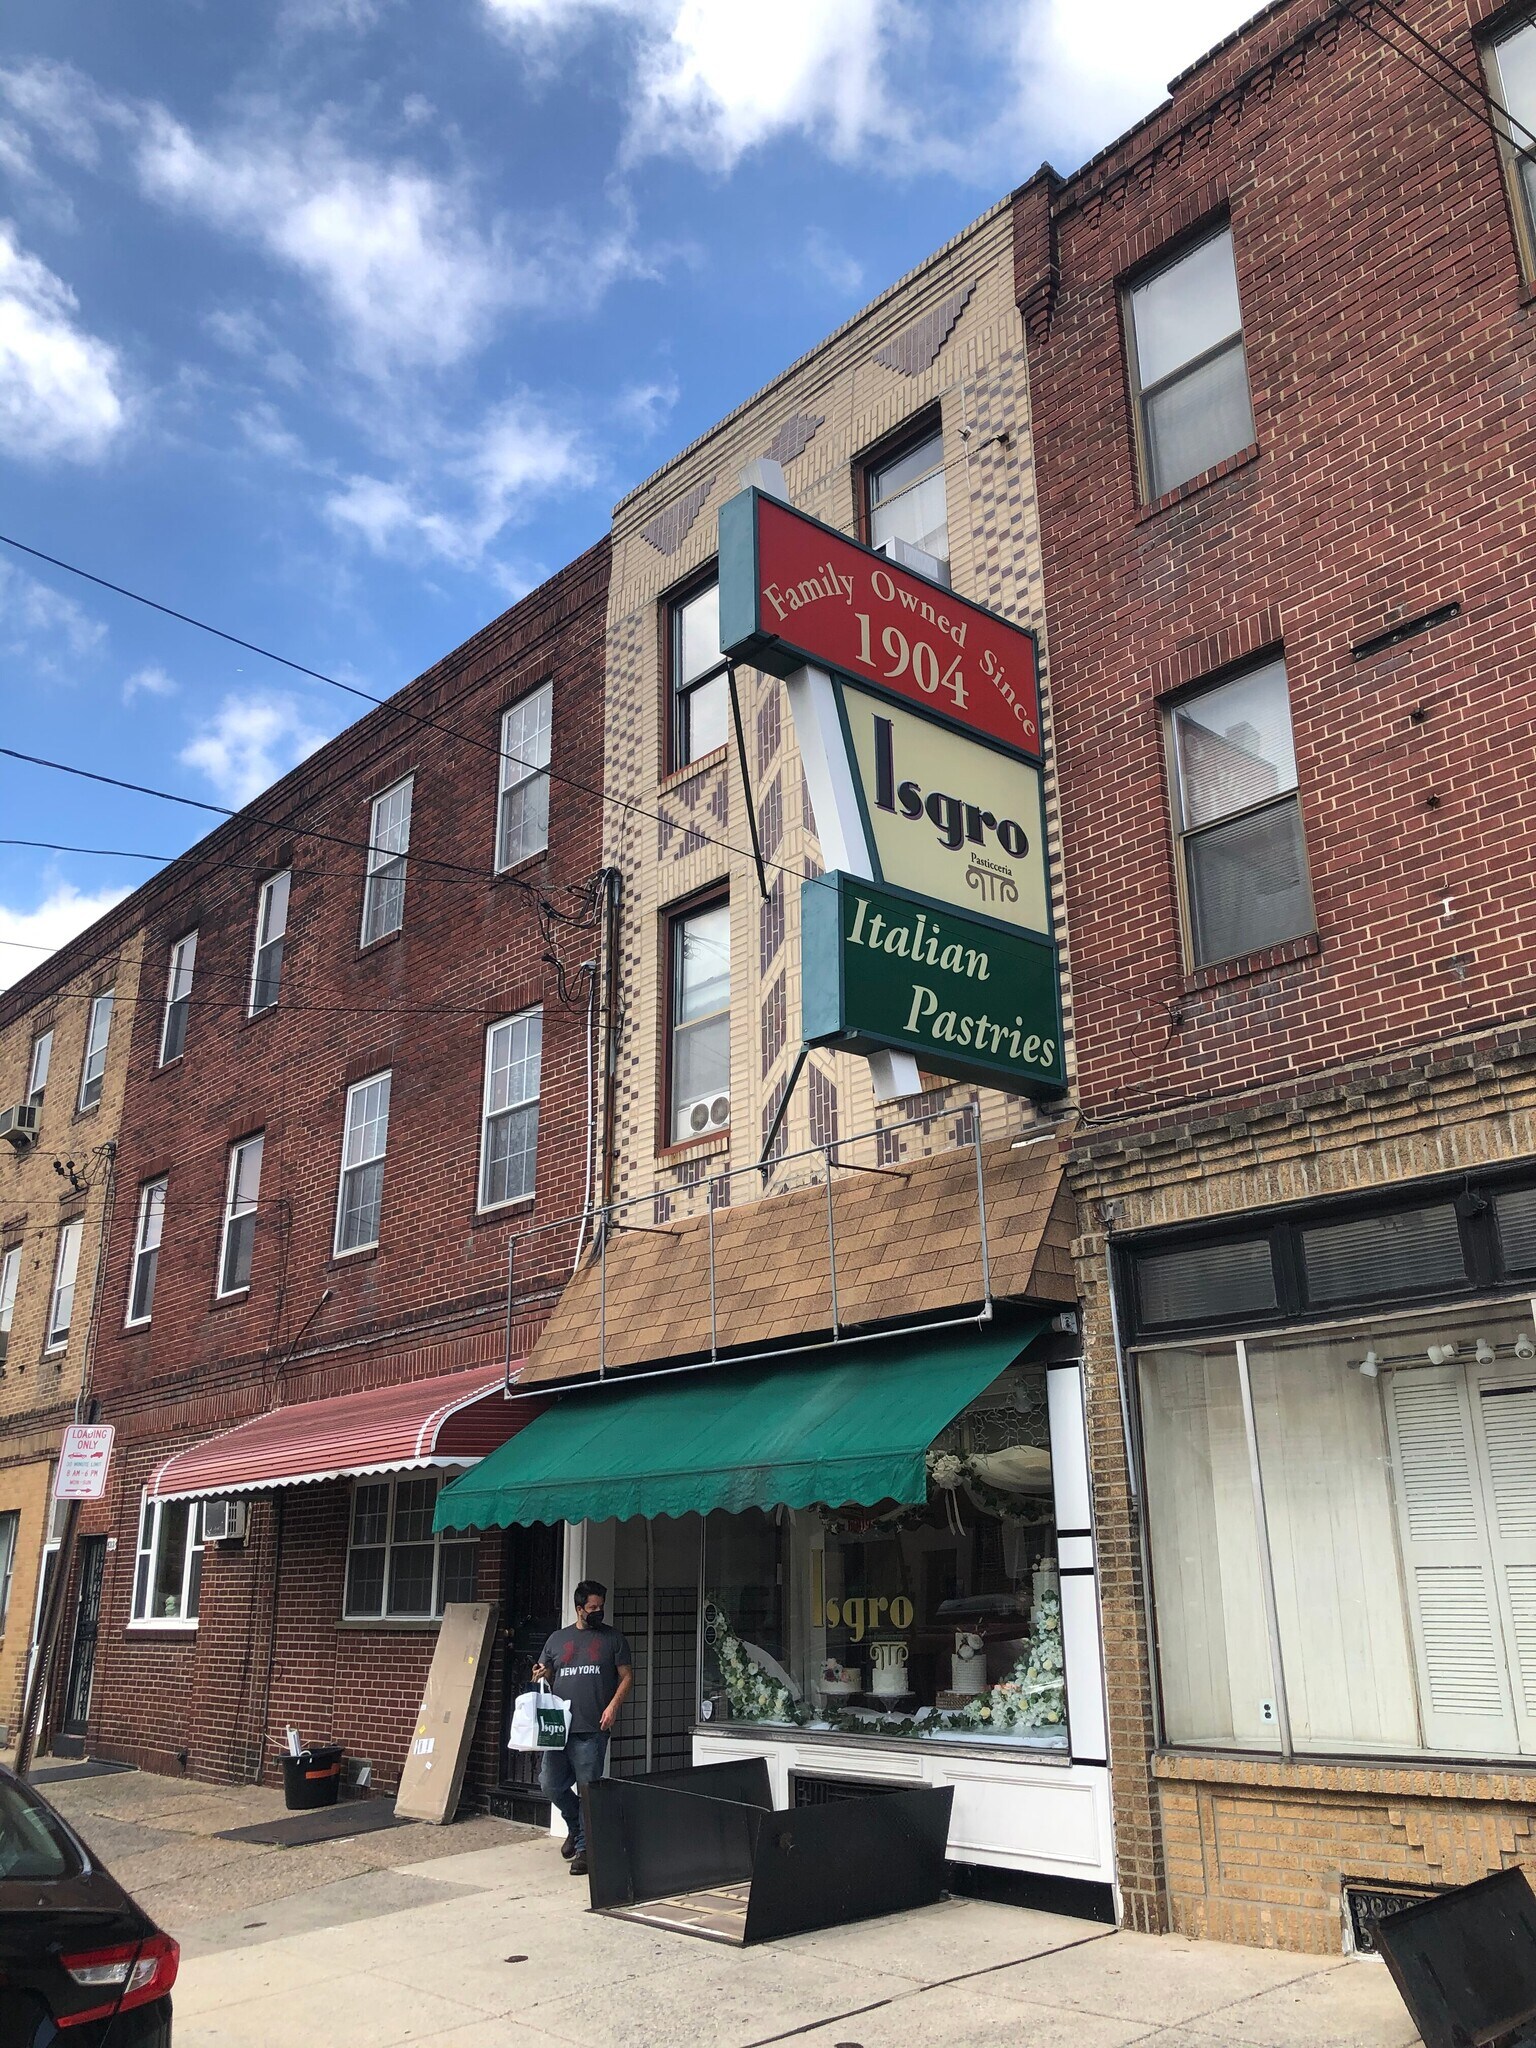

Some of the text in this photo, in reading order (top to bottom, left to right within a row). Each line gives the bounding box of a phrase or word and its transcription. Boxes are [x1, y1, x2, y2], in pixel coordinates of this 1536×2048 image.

[762, 562, 1035, 737] Family Owned Since
[854, 612, 969, 711] 1904
[872, 712, 1029, 859] Isgro
[971, 851, 1012, 876] Pasticceria
[846, 896, 990, 981] Italian
[902, 984, 1055, 1068] Pastries
[77, 1440, 98, 1450] ONLY
[811, 1548, 914, 1642] Isgro
[560, 1665, 600, 1677] NEW YORK
[540, 1715, 565, 1736] Isgro
